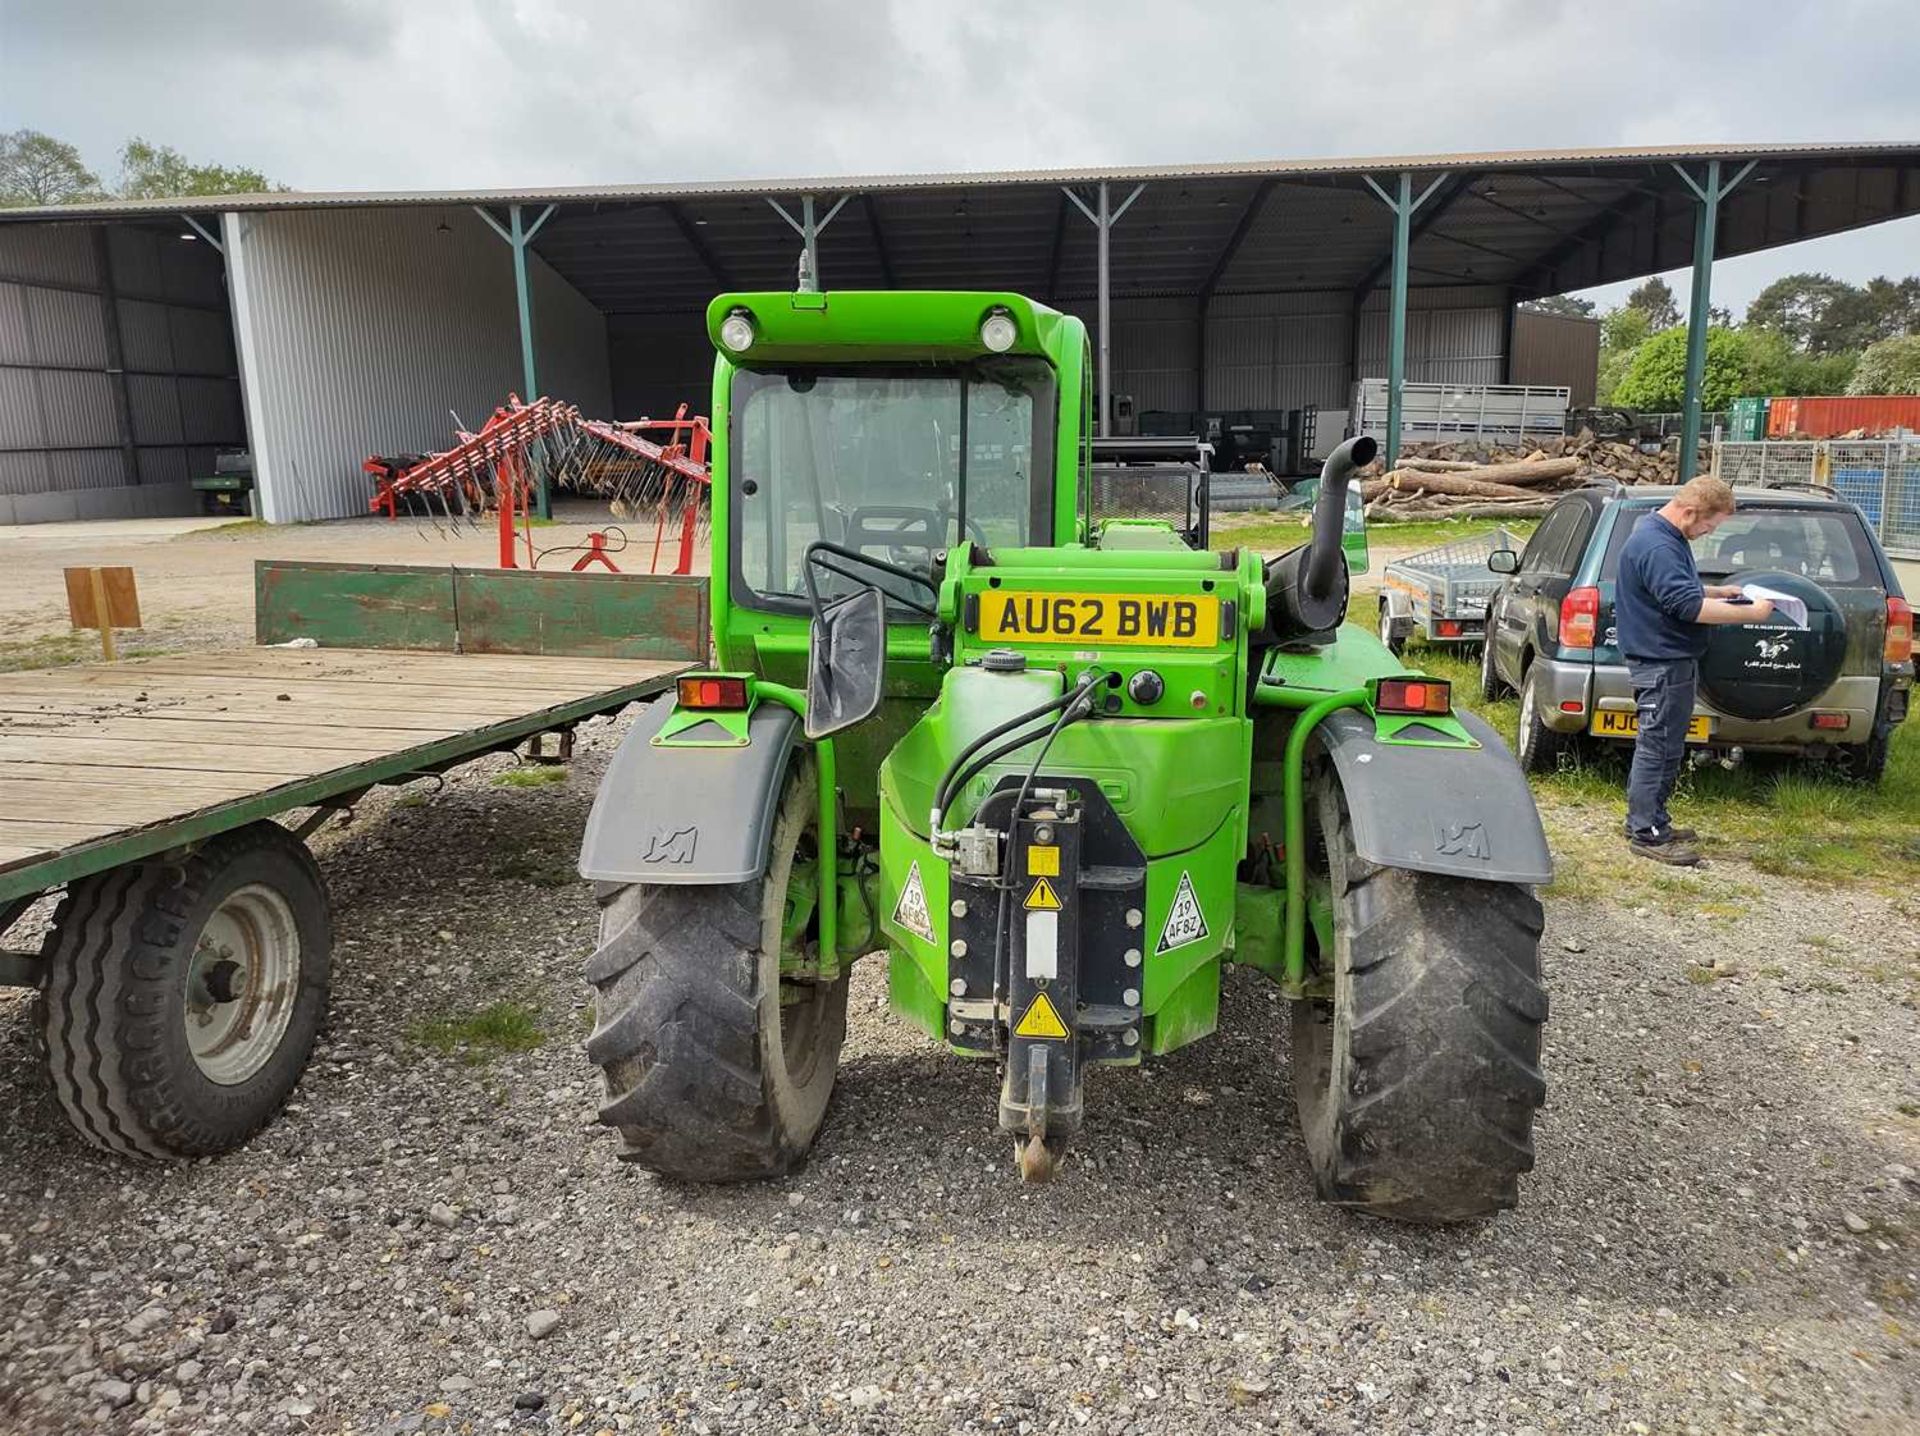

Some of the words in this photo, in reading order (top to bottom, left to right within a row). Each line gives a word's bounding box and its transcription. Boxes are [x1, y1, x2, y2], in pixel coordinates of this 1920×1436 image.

[999, 597, 1104, 636] AU62
[1117, 600, 1197, 638] BWB
[909, 889, 921, 905] 19
[1177, 900, 1191, 917] 19
[1169, 915, 1197, 938] AF8Z
